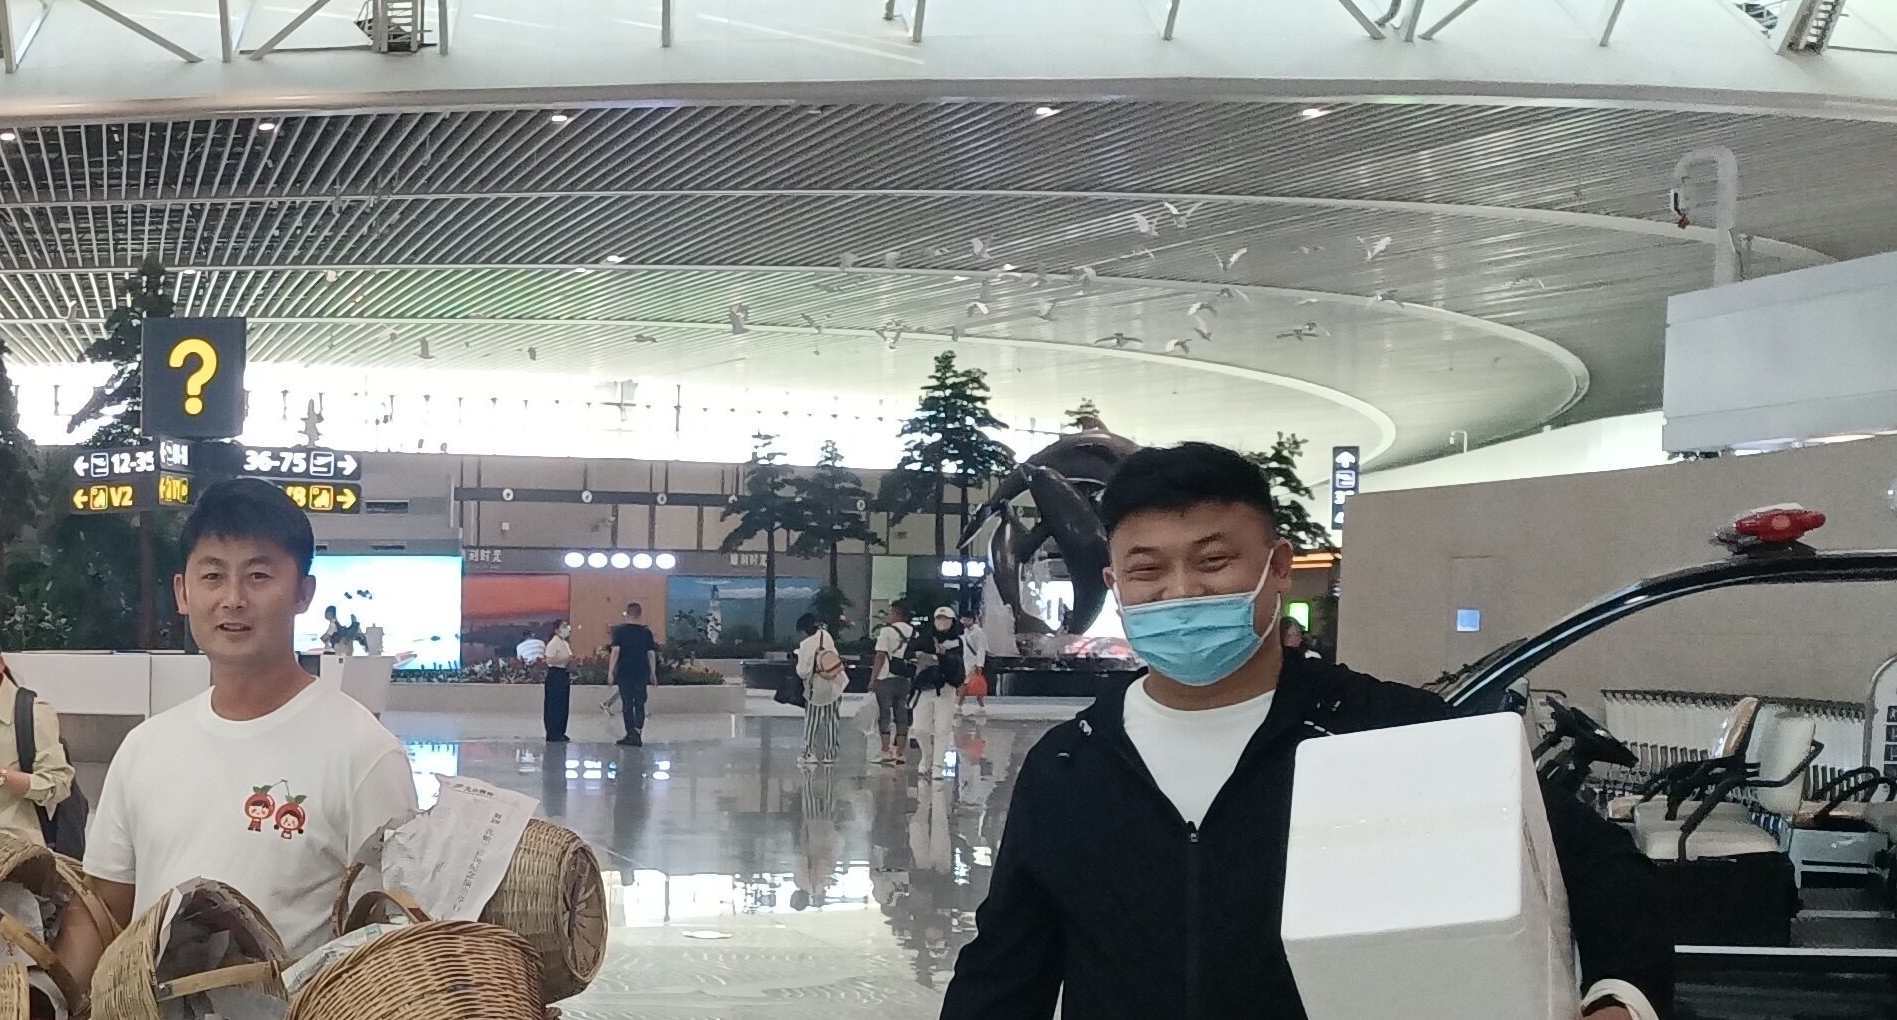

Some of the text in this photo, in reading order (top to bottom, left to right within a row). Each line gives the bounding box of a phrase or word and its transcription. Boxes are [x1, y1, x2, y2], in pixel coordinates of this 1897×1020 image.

[110, 450, 155, 474] 12-35
[243, 449, 307, 474] 36-75
[109, 485, 134, 508] V2
